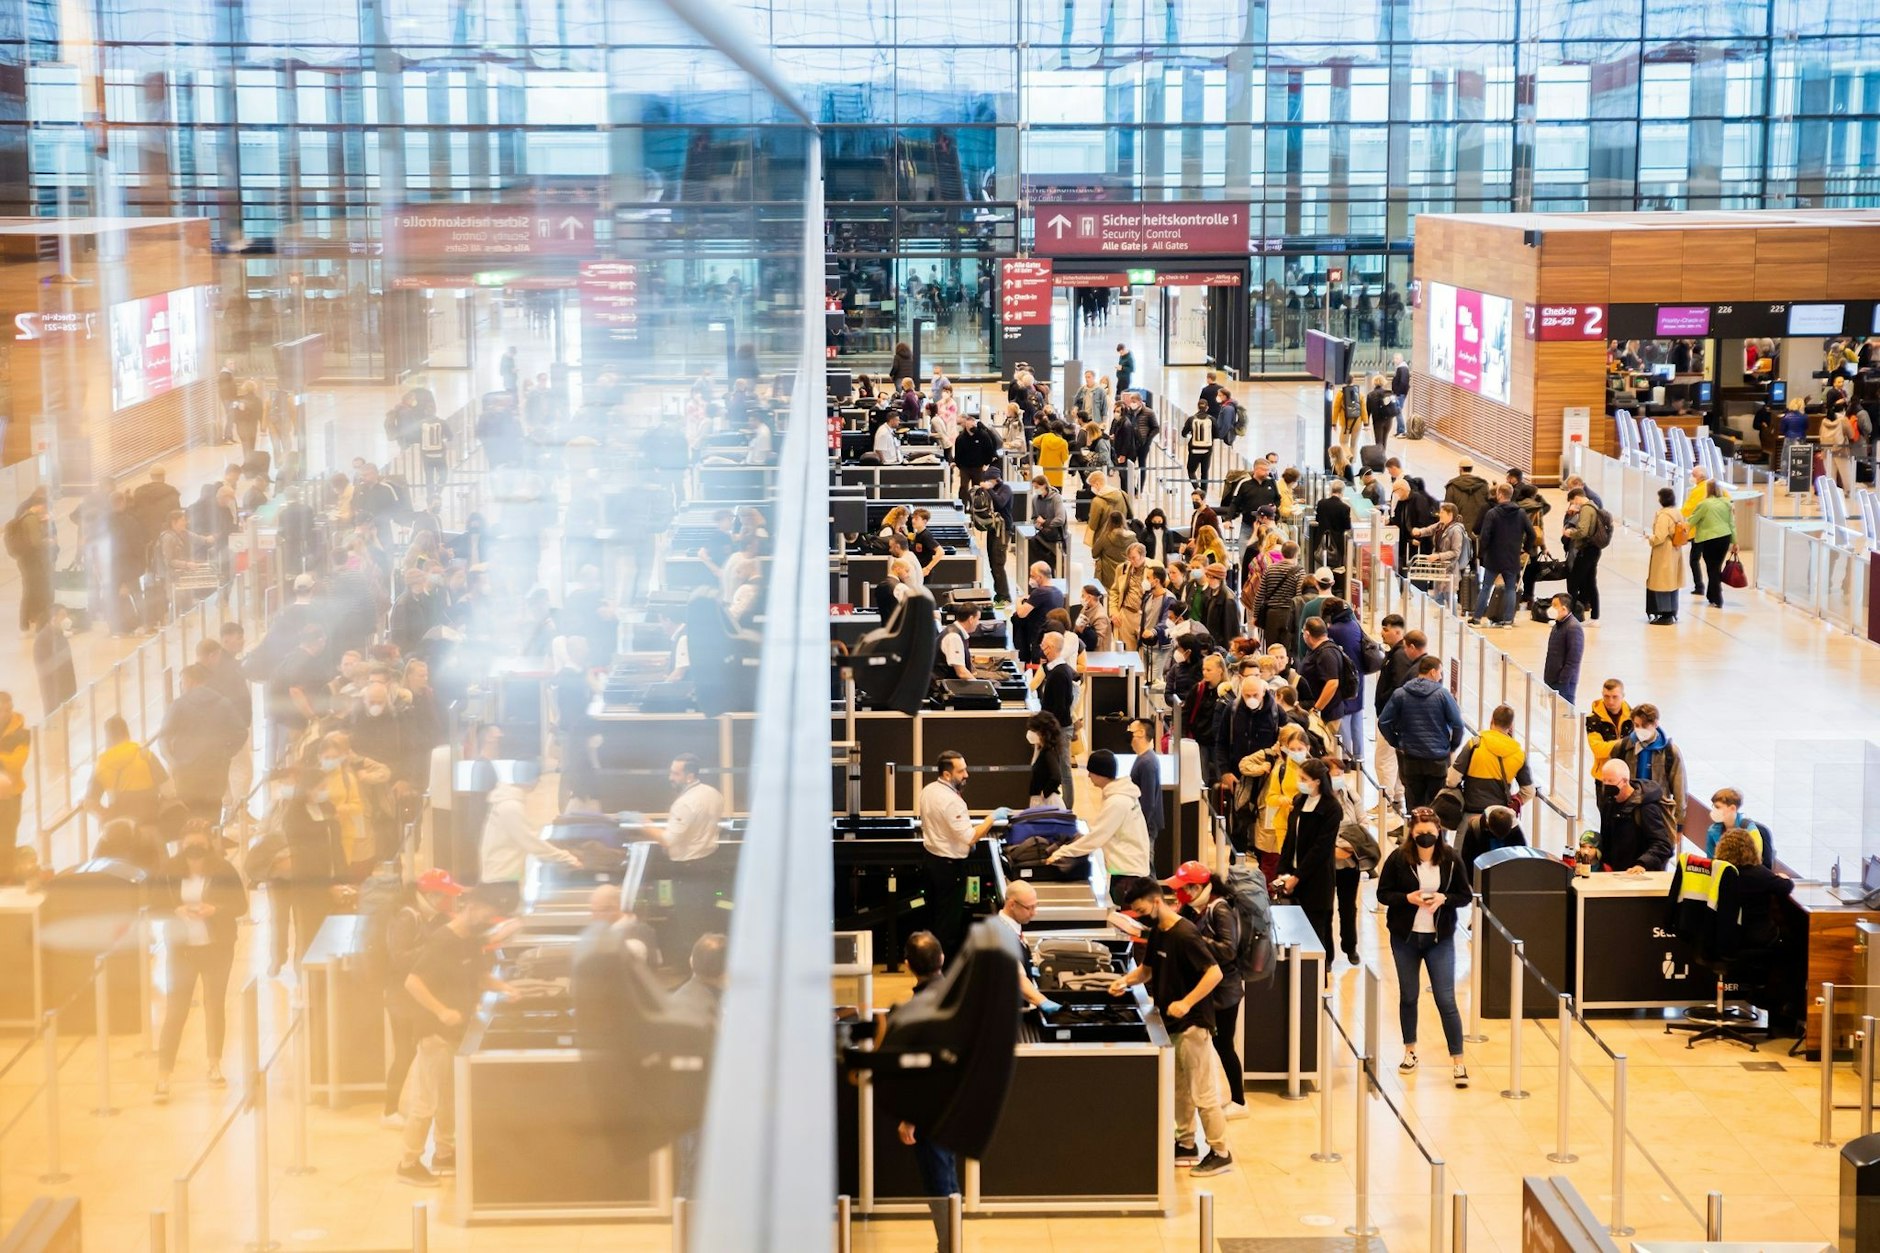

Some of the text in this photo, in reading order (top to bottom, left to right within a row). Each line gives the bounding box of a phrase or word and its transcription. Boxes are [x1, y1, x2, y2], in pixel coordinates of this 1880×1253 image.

[1232, 214, 1238, 225] 1
[1102, 228, 1181, 241] Security Control
[1102, 241, 1189, 251] Alle Gates All Gates
[1718, 306, 1733, 314] 226
[1769, 305, 1785, 313] 225
[1541, 306, 1577, 316] Check-in
[1583, 306, 1603, 335] 2
